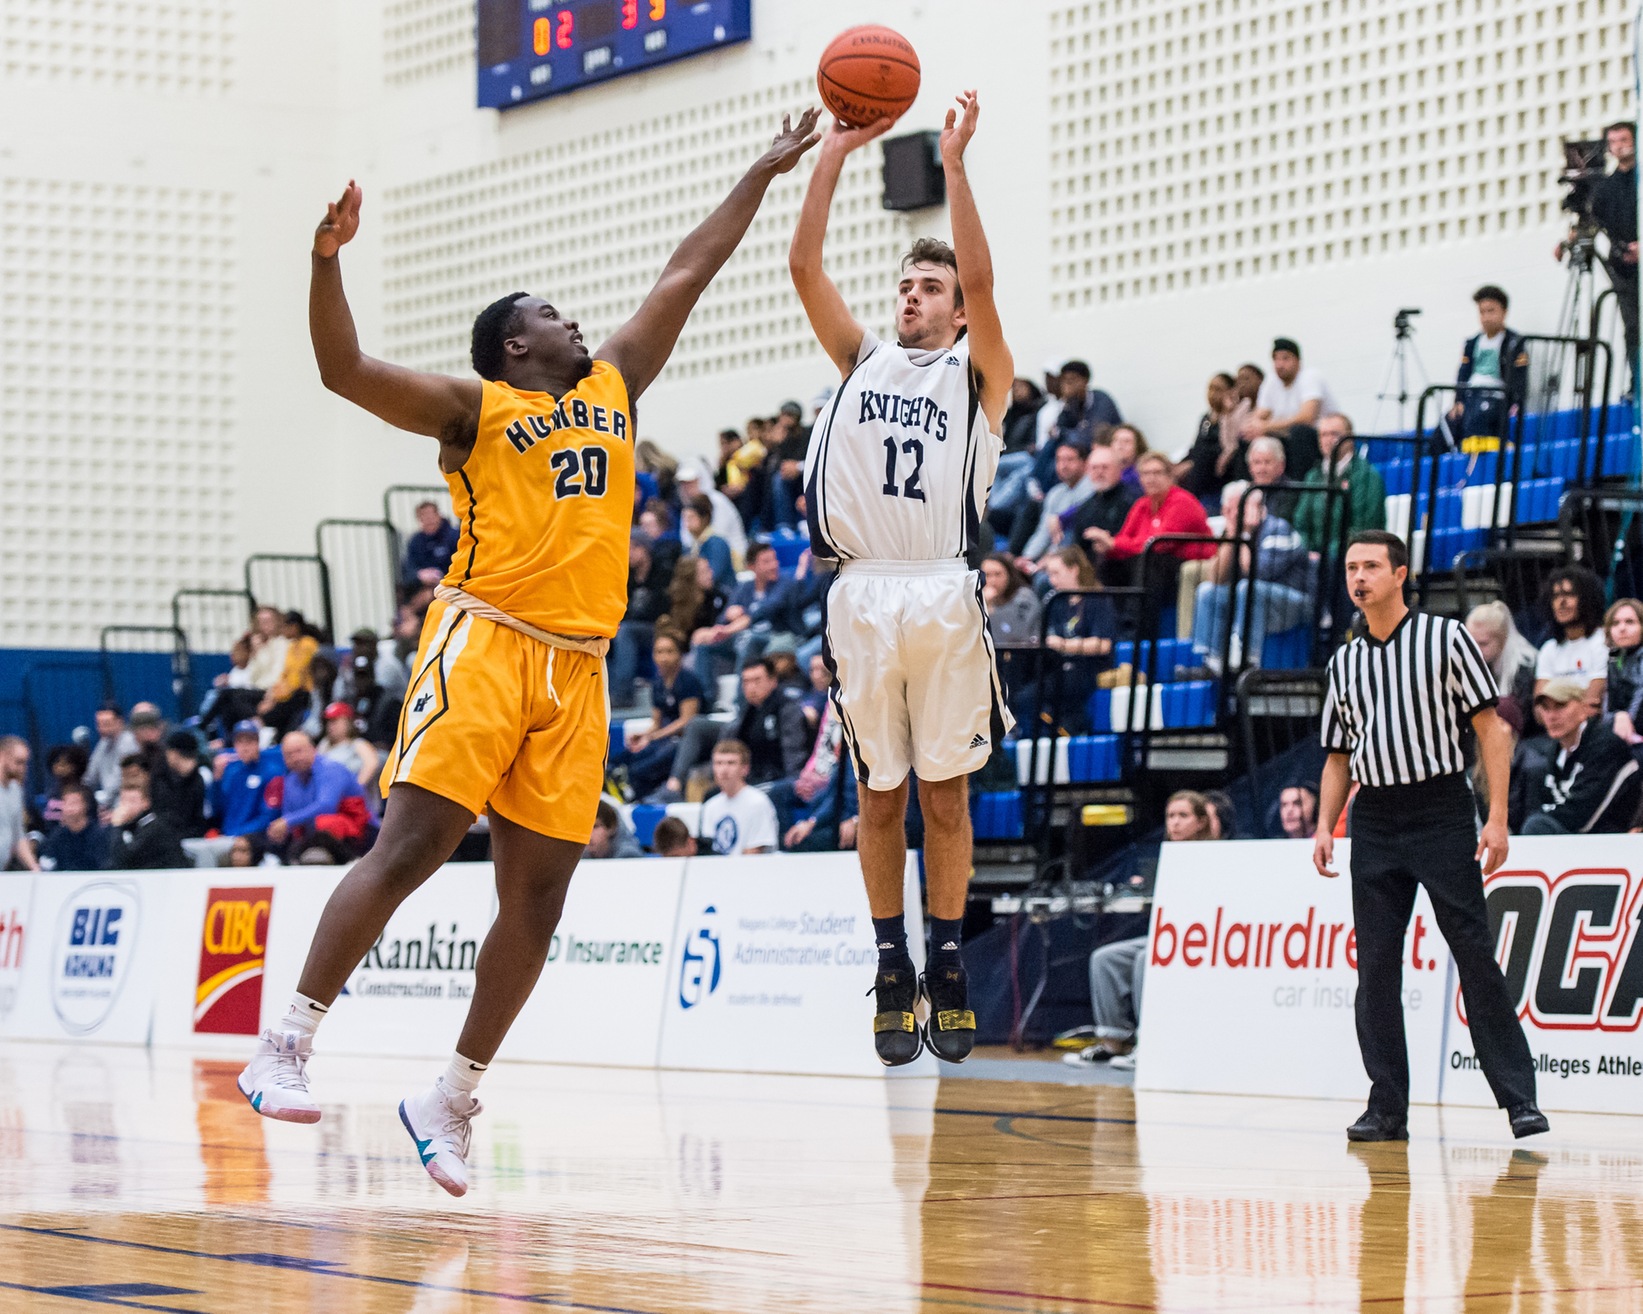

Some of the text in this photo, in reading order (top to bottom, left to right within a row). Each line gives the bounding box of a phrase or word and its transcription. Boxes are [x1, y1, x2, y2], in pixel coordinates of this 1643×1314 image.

[505, 399, 627, 455] HUMBER
[859, 390, 948, 442] KNIGHTS
[550, 446, 608, 500] 20
[883, 435, 926, 503] 12
[204, 900, 270, 955] CIBC
[361, 922, 477, 970] Rankin
[800, 911, 857, 935] Student
[1151, 906, 1436, 971] belairdiret.
[566, 933, 663, 964] Insurance
[356, 976, 442, 997] Construction
[1272, 986, 1307, 1008] car
[1532, 1054, 1591, 1078] olleges
